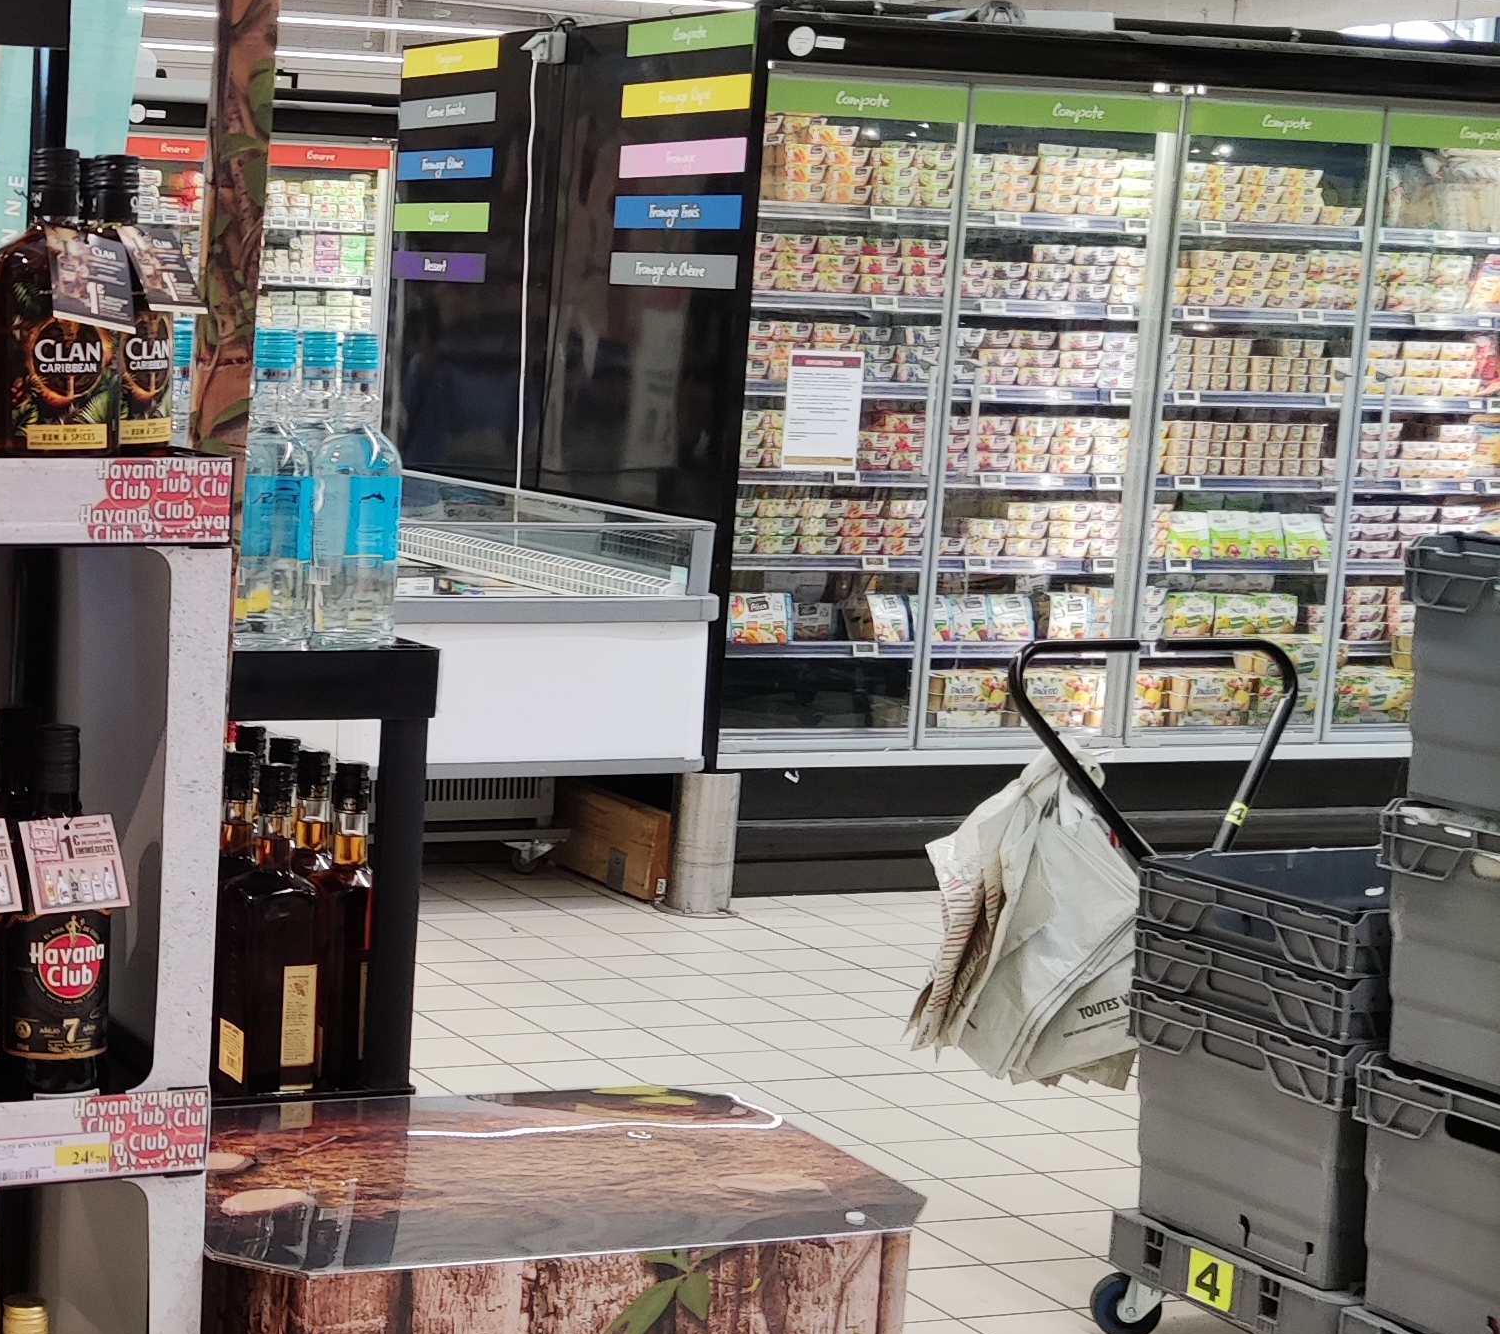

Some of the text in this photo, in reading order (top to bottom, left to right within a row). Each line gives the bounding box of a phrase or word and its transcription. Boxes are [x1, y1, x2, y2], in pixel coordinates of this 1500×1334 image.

[835, 90, 890, 112] Compote
[1052, 103, 1106, 124] Compote
[1261, 114, 1313, 134] Compote
[1460, 126, 1500, 147] Compot
[1230, 803, 1247, 823] 4
[30, 942, 105, 965] Havana
[46, 966, 93, 986] Club
[1077, 997, 1120, 1019] TOUTES
[63, 1018, 81, 1044] 7
[1193, 1261, 1222, 1303] 4
